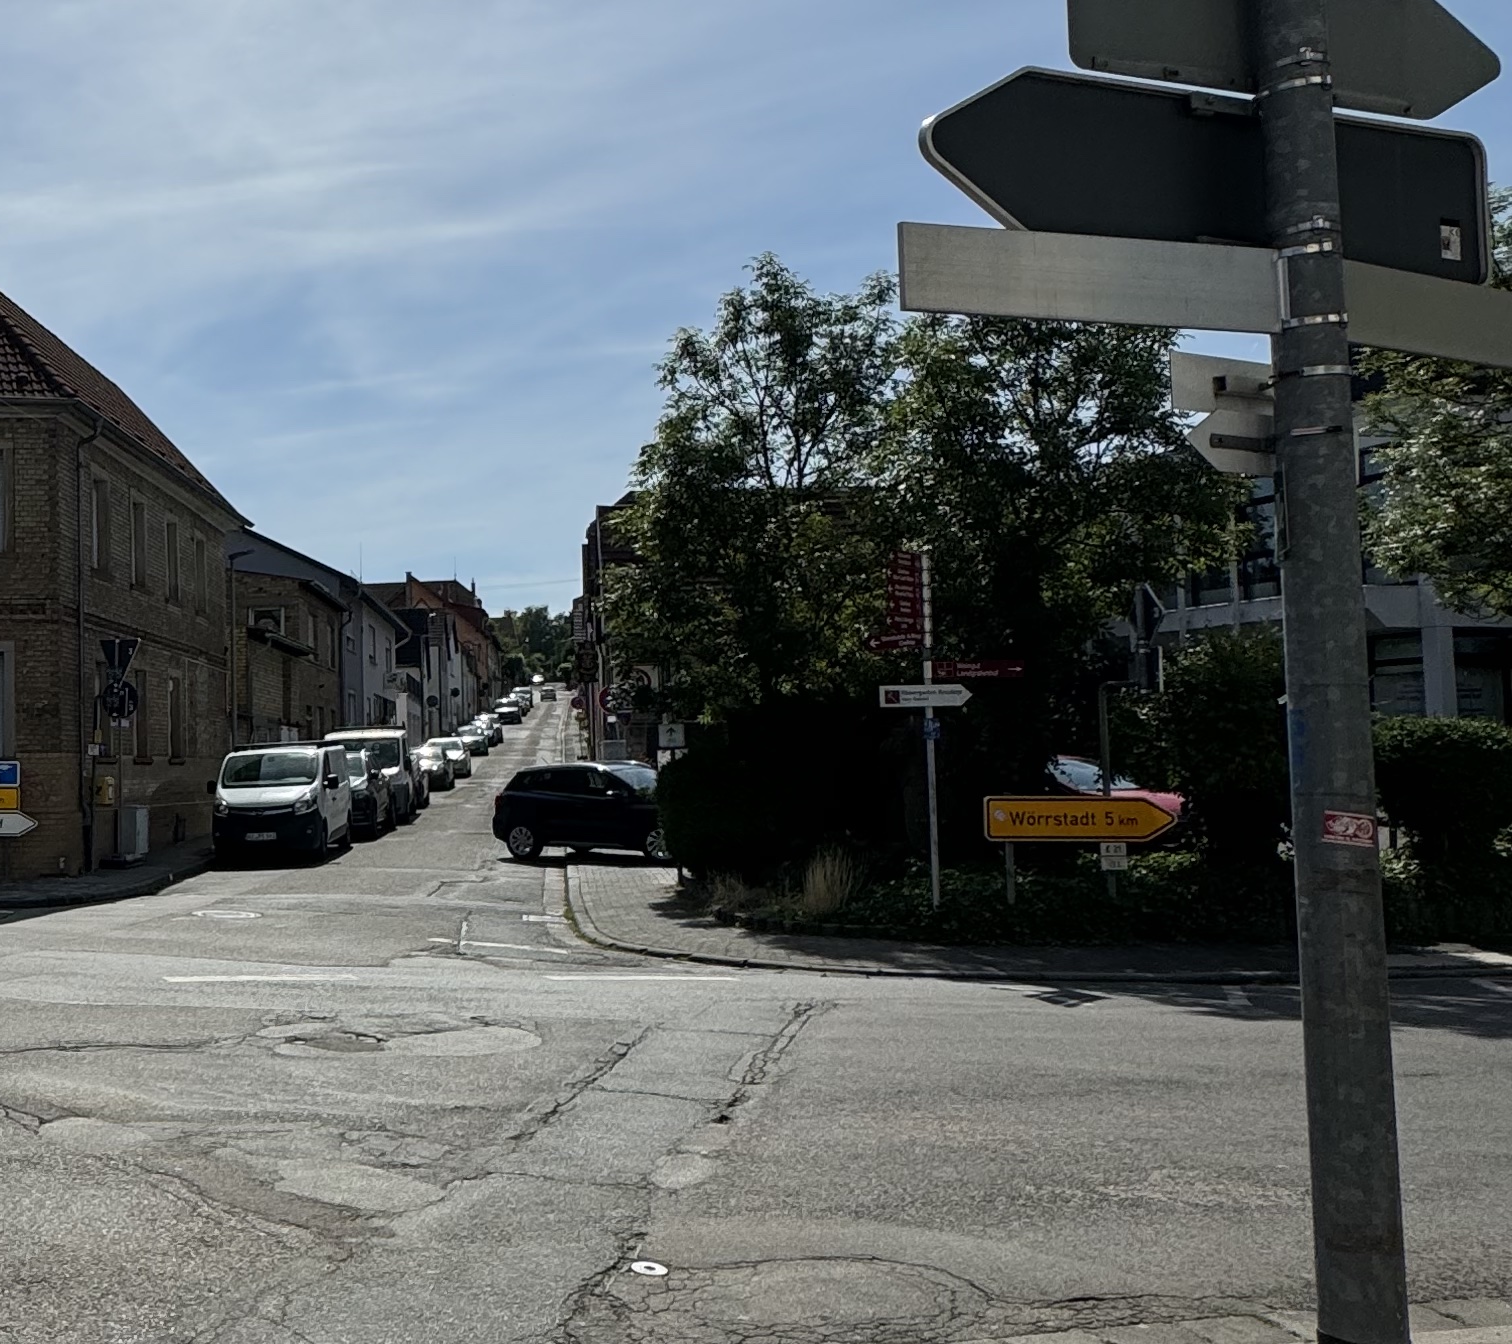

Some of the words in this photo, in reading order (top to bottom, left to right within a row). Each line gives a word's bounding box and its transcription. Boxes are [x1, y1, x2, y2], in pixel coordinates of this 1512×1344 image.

[1009, 811, 1096, 826] Wörrstadt
[1105, 811, 1114, 826] 5
[1119, 814, 1138, 826] km
